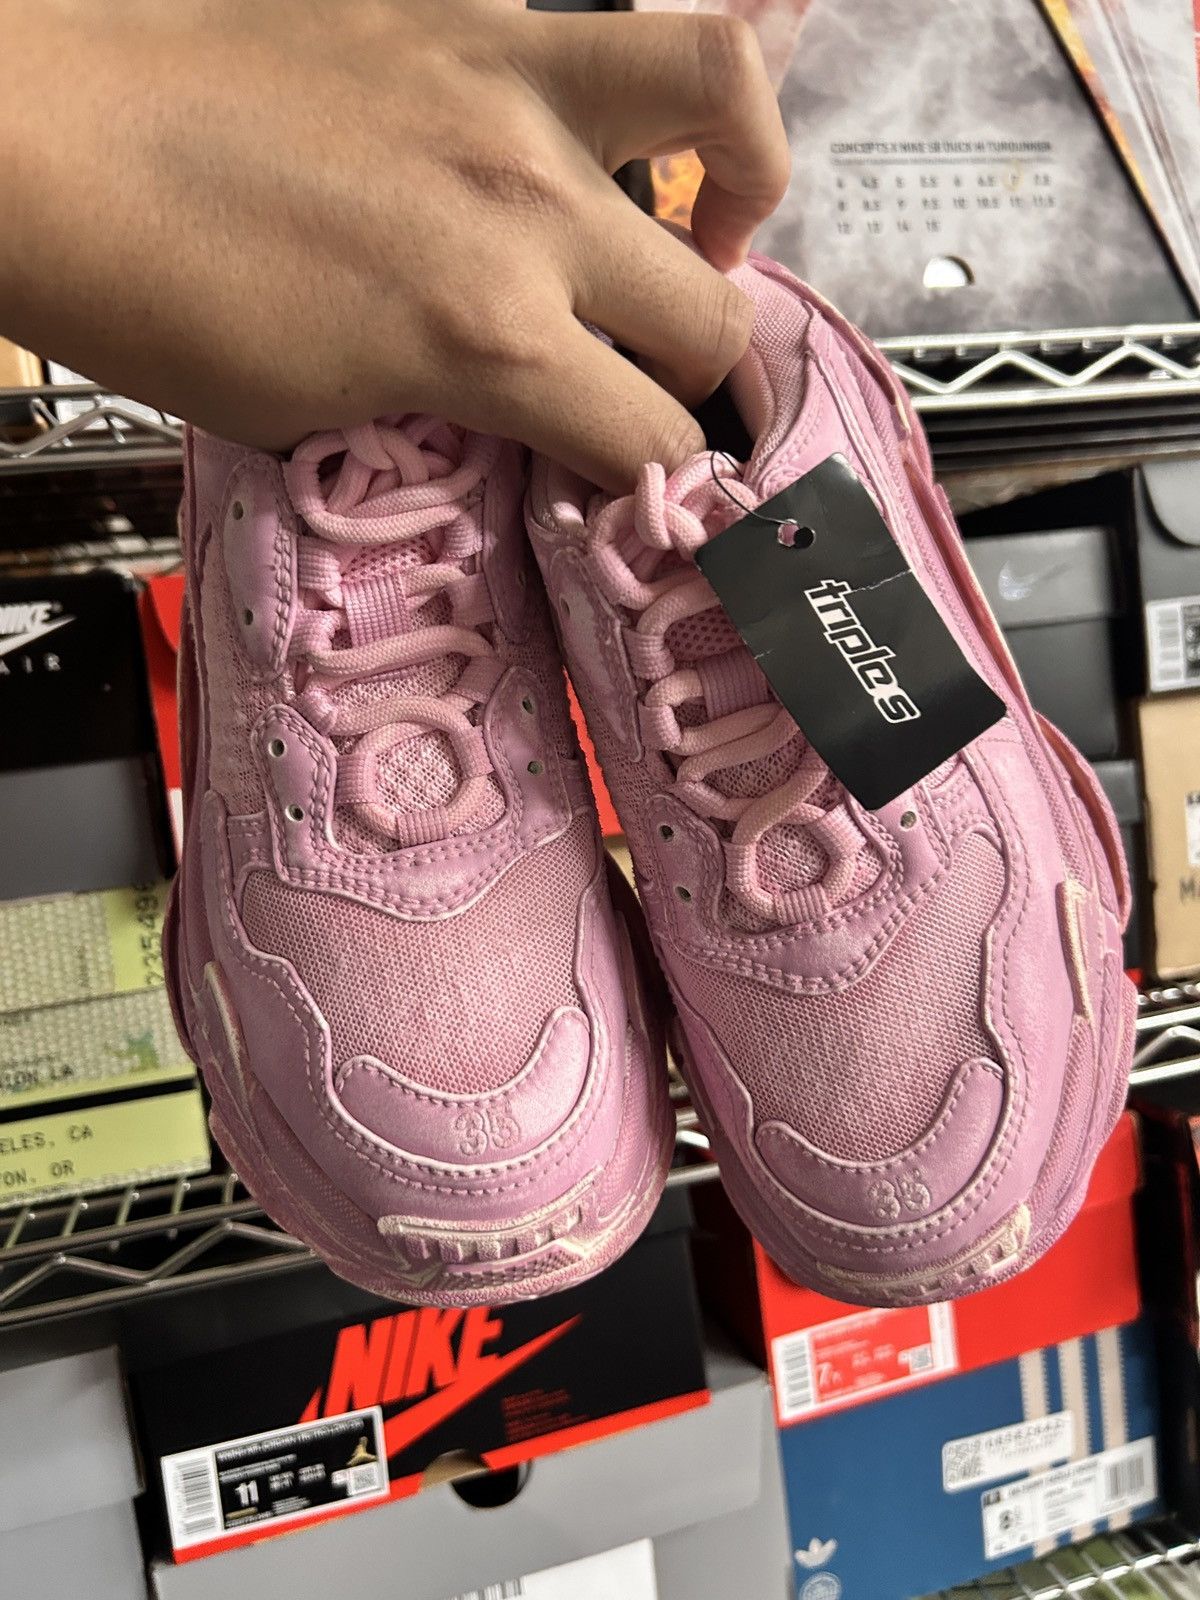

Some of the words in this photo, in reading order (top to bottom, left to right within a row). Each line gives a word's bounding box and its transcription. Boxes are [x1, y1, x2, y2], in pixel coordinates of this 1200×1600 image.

[68, 1124, 94, 1142] CA
[50, 1159, 75, 1178] OR
[324, 1306, 503, 1416] NIKE
[234, 1480, 260, 1507] 11
